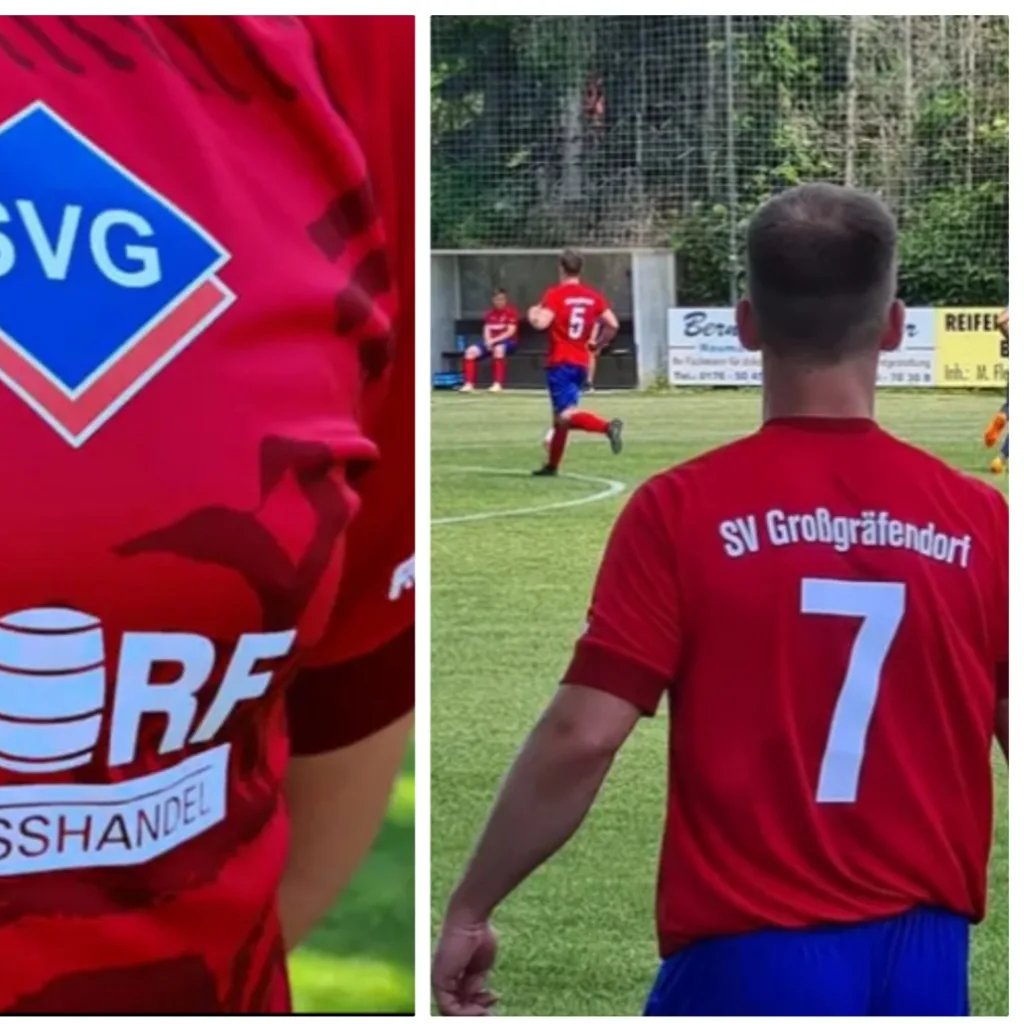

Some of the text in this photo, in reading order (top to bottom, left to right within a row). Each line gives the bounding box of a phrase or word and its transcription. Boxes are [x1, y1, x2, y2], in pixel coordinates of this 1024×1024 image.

[568, 307, 585, 339] 5
[719, 507, 972, 568] SV Großgräfendorf
[800, 577, 905, 803] 7
